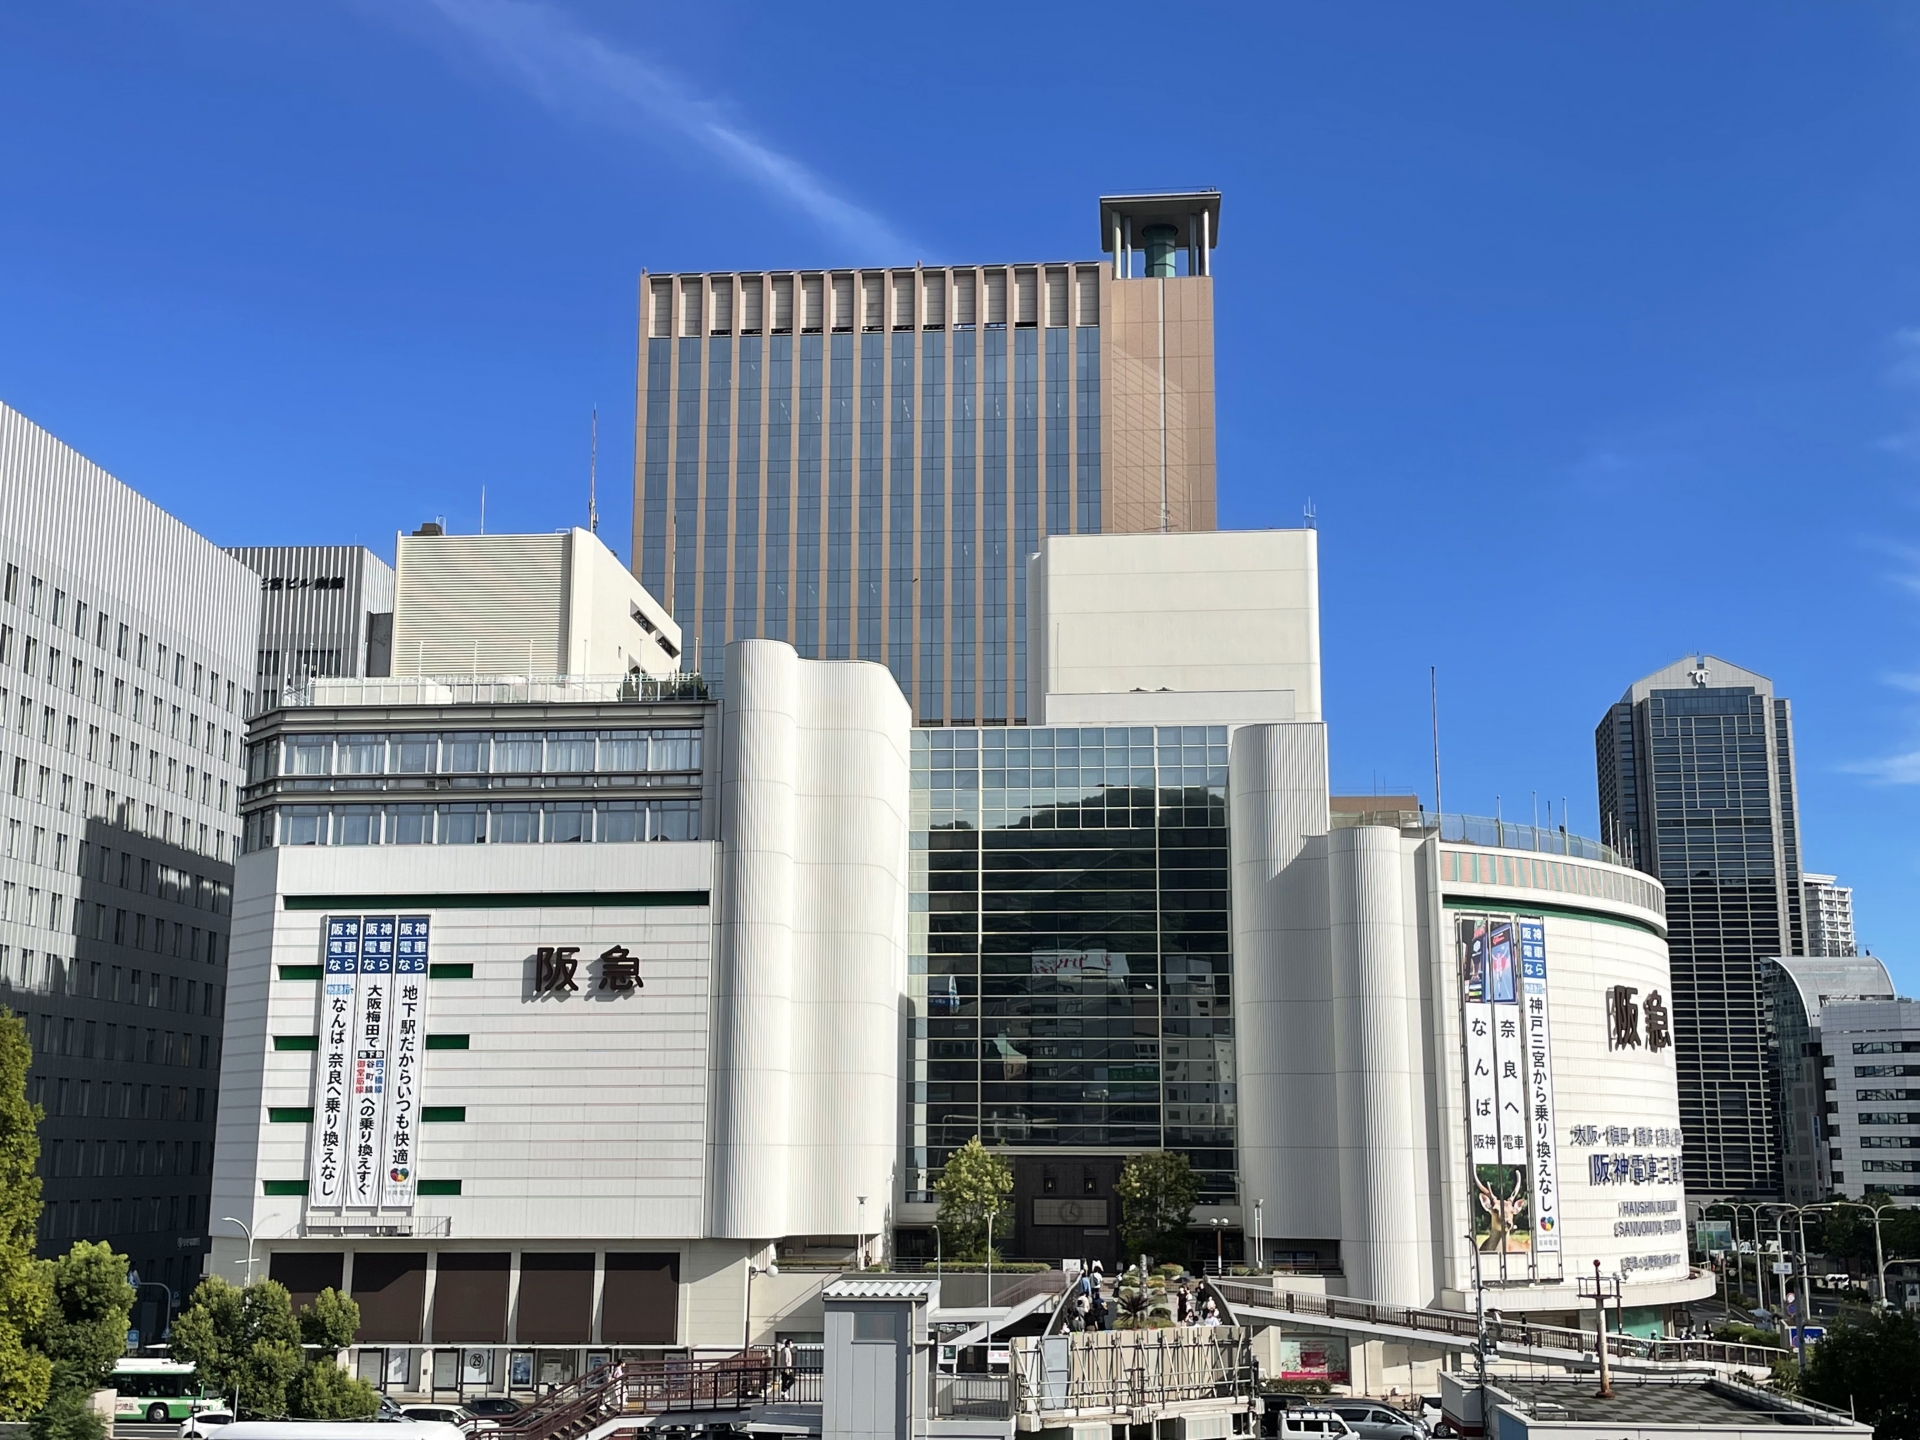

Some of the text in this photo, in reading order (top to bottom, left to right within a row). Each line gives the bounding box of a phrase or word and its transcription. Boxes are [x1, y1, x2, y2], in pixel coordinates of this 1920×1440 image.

[330, 923, 358, 936] 阪神
[365, 923, 393, 936] 阪神
[400, 923, 428, 936] 阪神
[1522, 927, 1542, 940] 阪神
[330, 941, 357, 953] 電車
[364, 941, 392, 953] 電車
[400, 941, 426, 953] 電車
[328, 959, 355, 971] なら
[363, 959, 390, 971] なら
[398, 959, 425, 971] なら
[535, 944, 644, 992] 阪急
[1524, 963, 1544, 976] なら
[365, 985, 382, 1048] 大阪梅田で
[1607, 985, 1672, 1052] 阪急
[1472, 1019, 1492, 1117] なんば
[1501, 1019, 1520, 1114] 奈良へ
[392, 985, 418, 1165] 地下駅だからいつも快適
[321, 997, 347, 1196] なんば・奈良へ乗り換えなし
[1529, 997, 1552, 1212] 神戸三宮から乗り換えなし
[357, 1097, 376, 1195] への乗り換えすぐ
[1473, 1134, 1525, 1150] 阪神 電車
[1619, 1201, 1657, 1215] HANSHIN
[1615, 1220, 1663, 1236] SANNOMIYA
